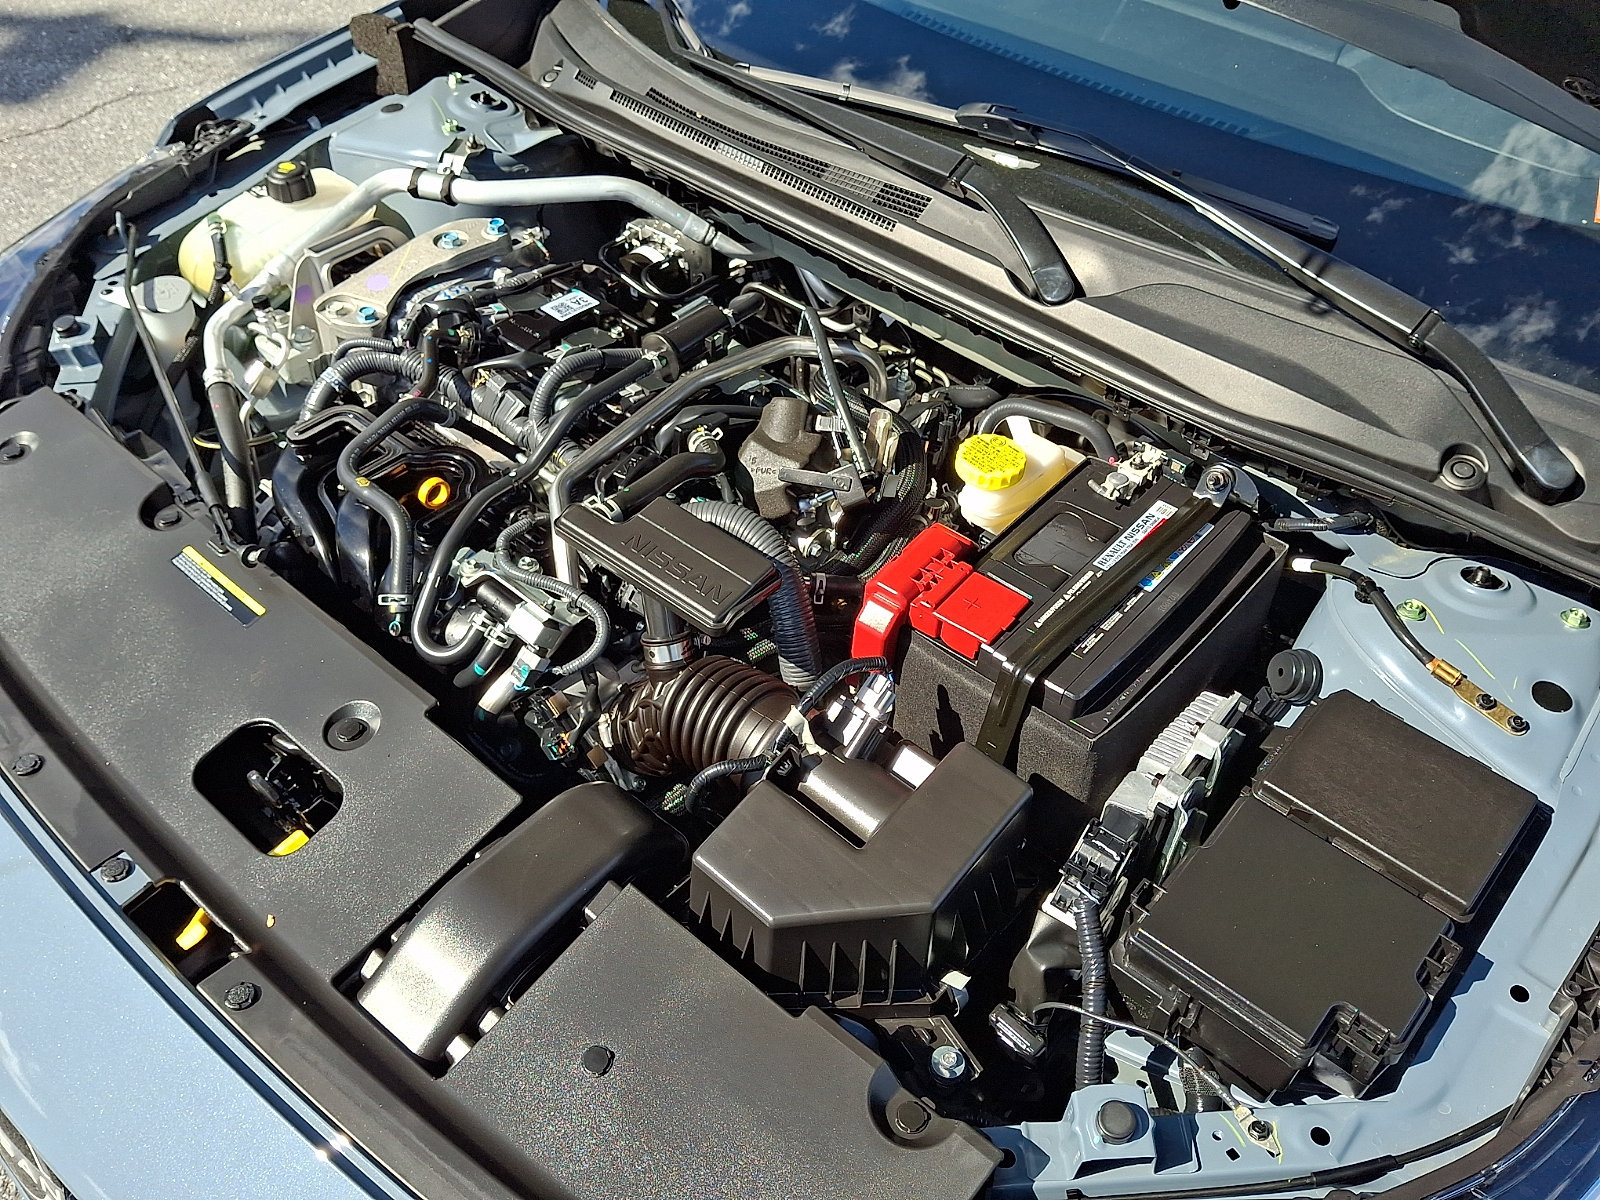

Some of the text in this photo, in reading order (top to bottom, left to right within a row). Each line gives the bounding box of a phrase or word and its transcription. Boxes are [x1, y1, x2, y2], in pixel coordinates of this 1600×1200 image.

[620, 533, 733, 605] NISSAN
[1097, 540, 1127, 566] RENAULT
[1124, 513, 1155, 541] NISSAN
